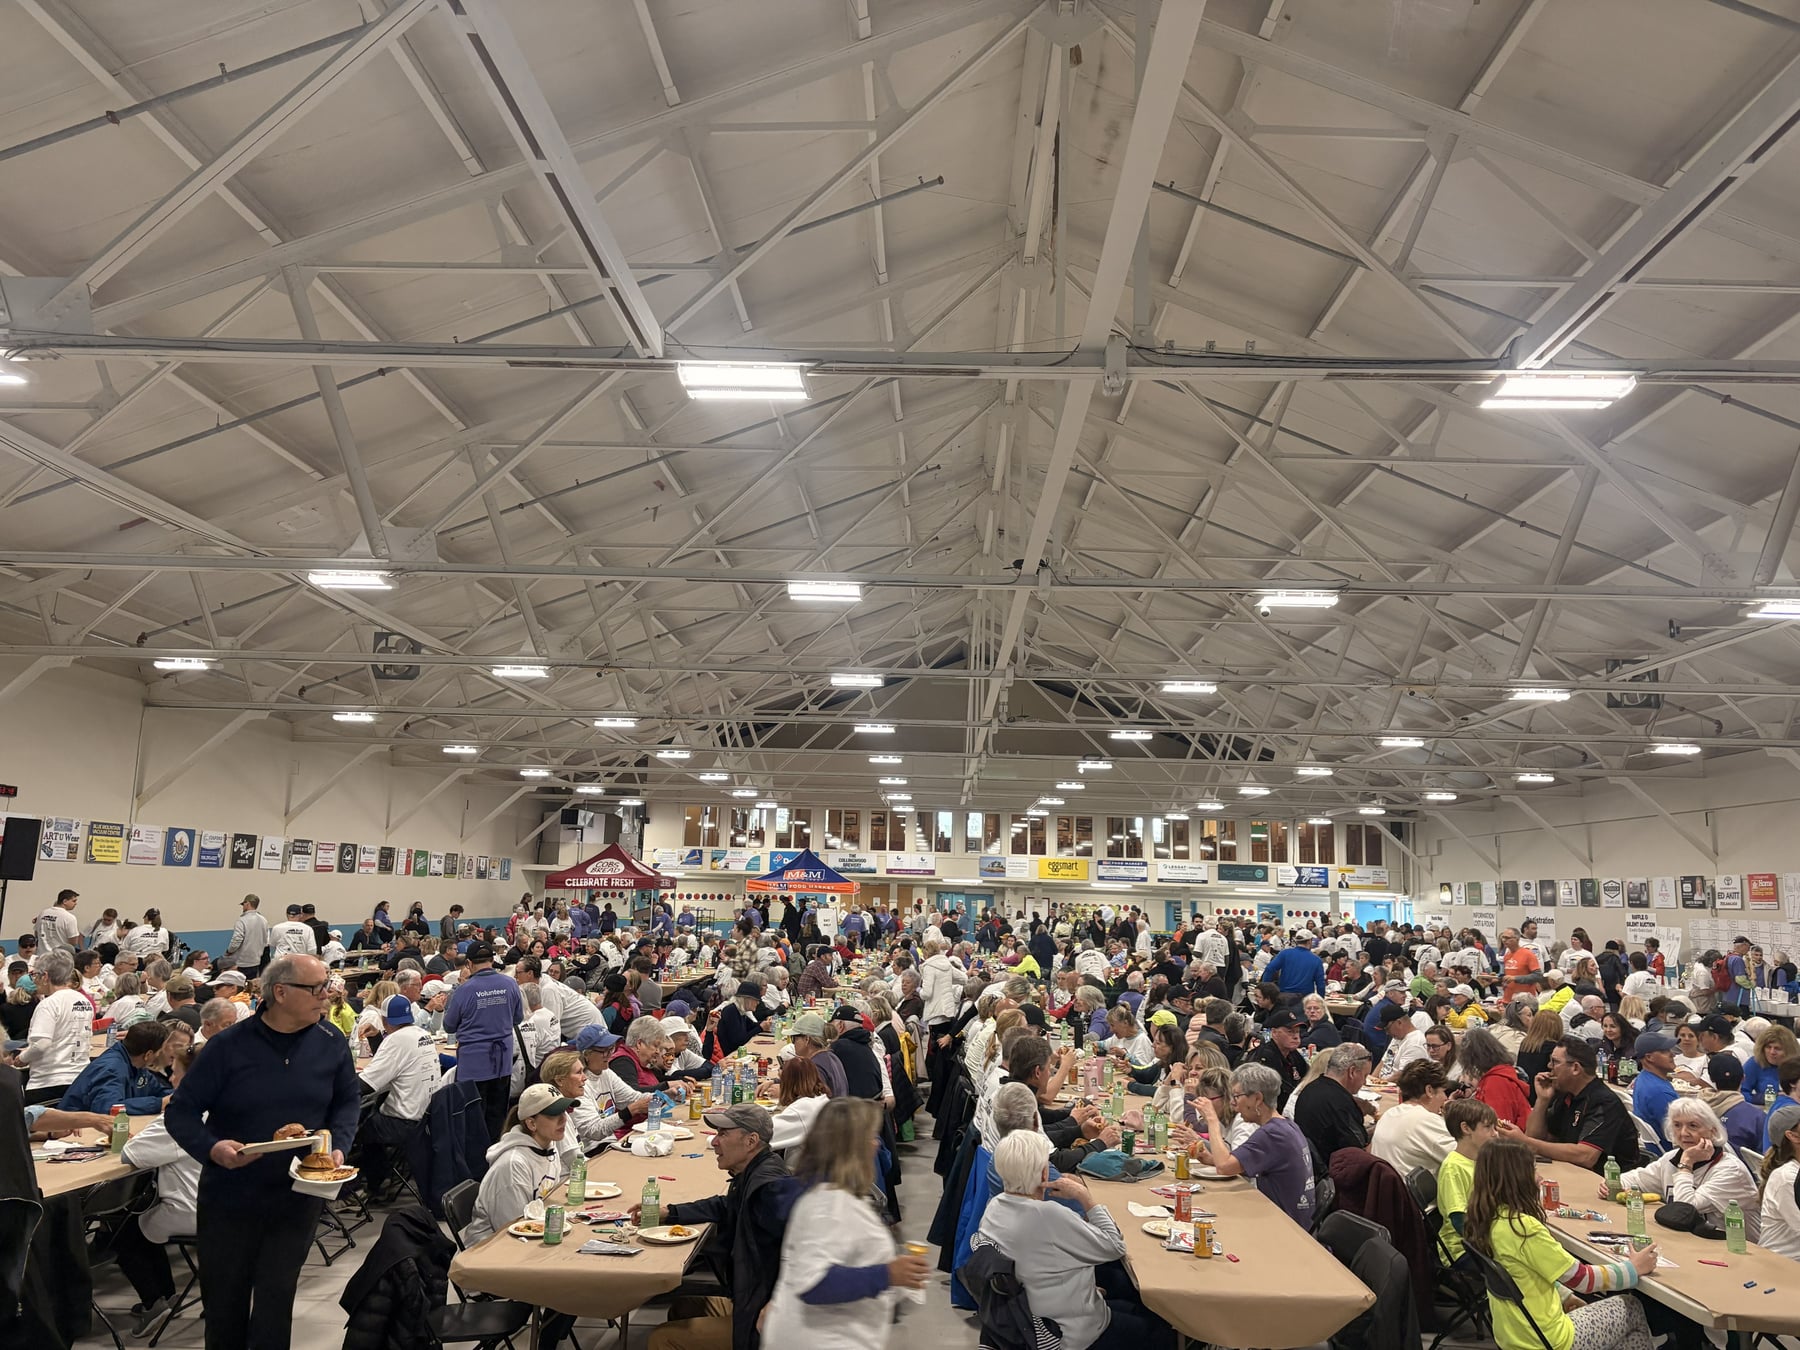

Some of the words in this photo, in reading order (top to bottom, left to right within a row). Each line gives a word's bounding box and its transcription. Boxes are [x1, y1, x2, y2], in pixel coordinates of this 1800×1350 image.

[43, 832, 59, 841] ART
[65, 833, 80, 843] Wear
[595, 860, 620, 868] COBS
[1047, 861, 1078, 872] eggsmart
[787, 871, 822, 879] M&M
[565, 878, 608, 887] CELEBRATE
[611, 878, 634, 887] FRESH
[476, 989, 507, 997] Volunteer
